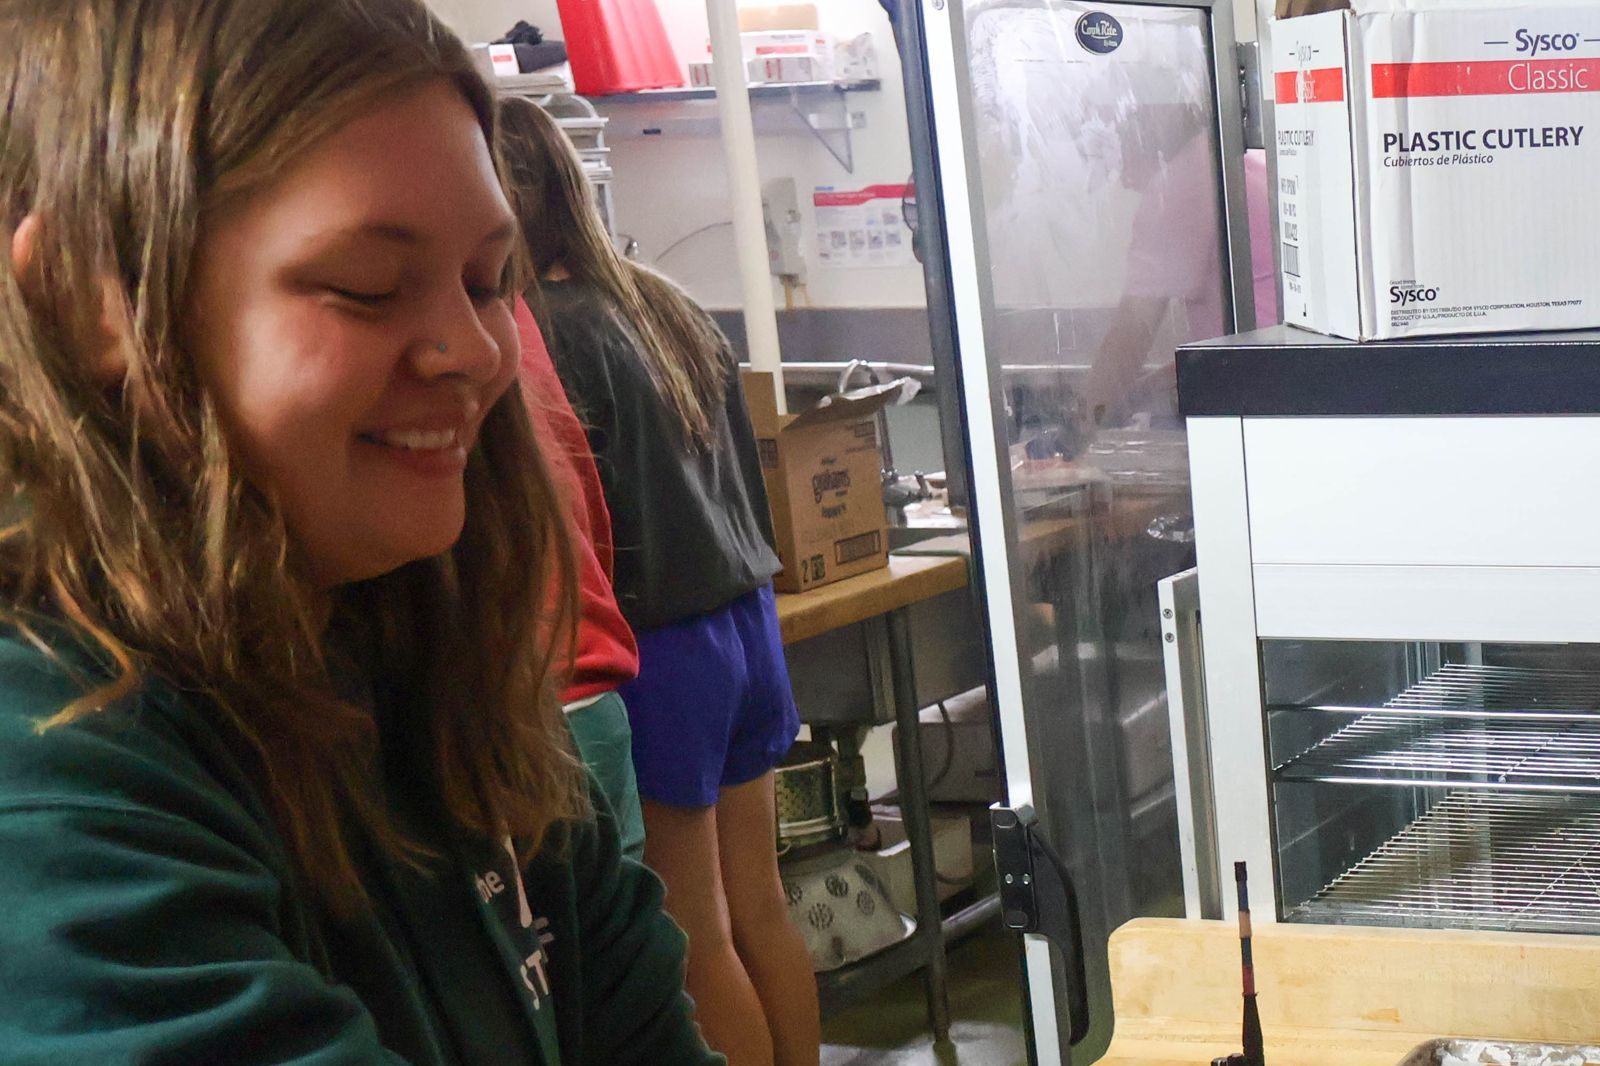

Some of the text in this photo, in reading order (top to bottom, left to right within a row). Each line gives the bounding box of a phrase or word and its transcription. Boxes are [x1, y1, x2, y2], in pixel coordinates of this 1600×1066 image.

[1515, 28, 1579, 57] Sysco
[1508, 63, 1588, 91] Classic
[1383, 126, 1584, 153] PLASTIC CUTLERY
[1383, 153, 1494, 167] Cubiertos de Plástico
[1390, 286, 1437, 306] Sysco
